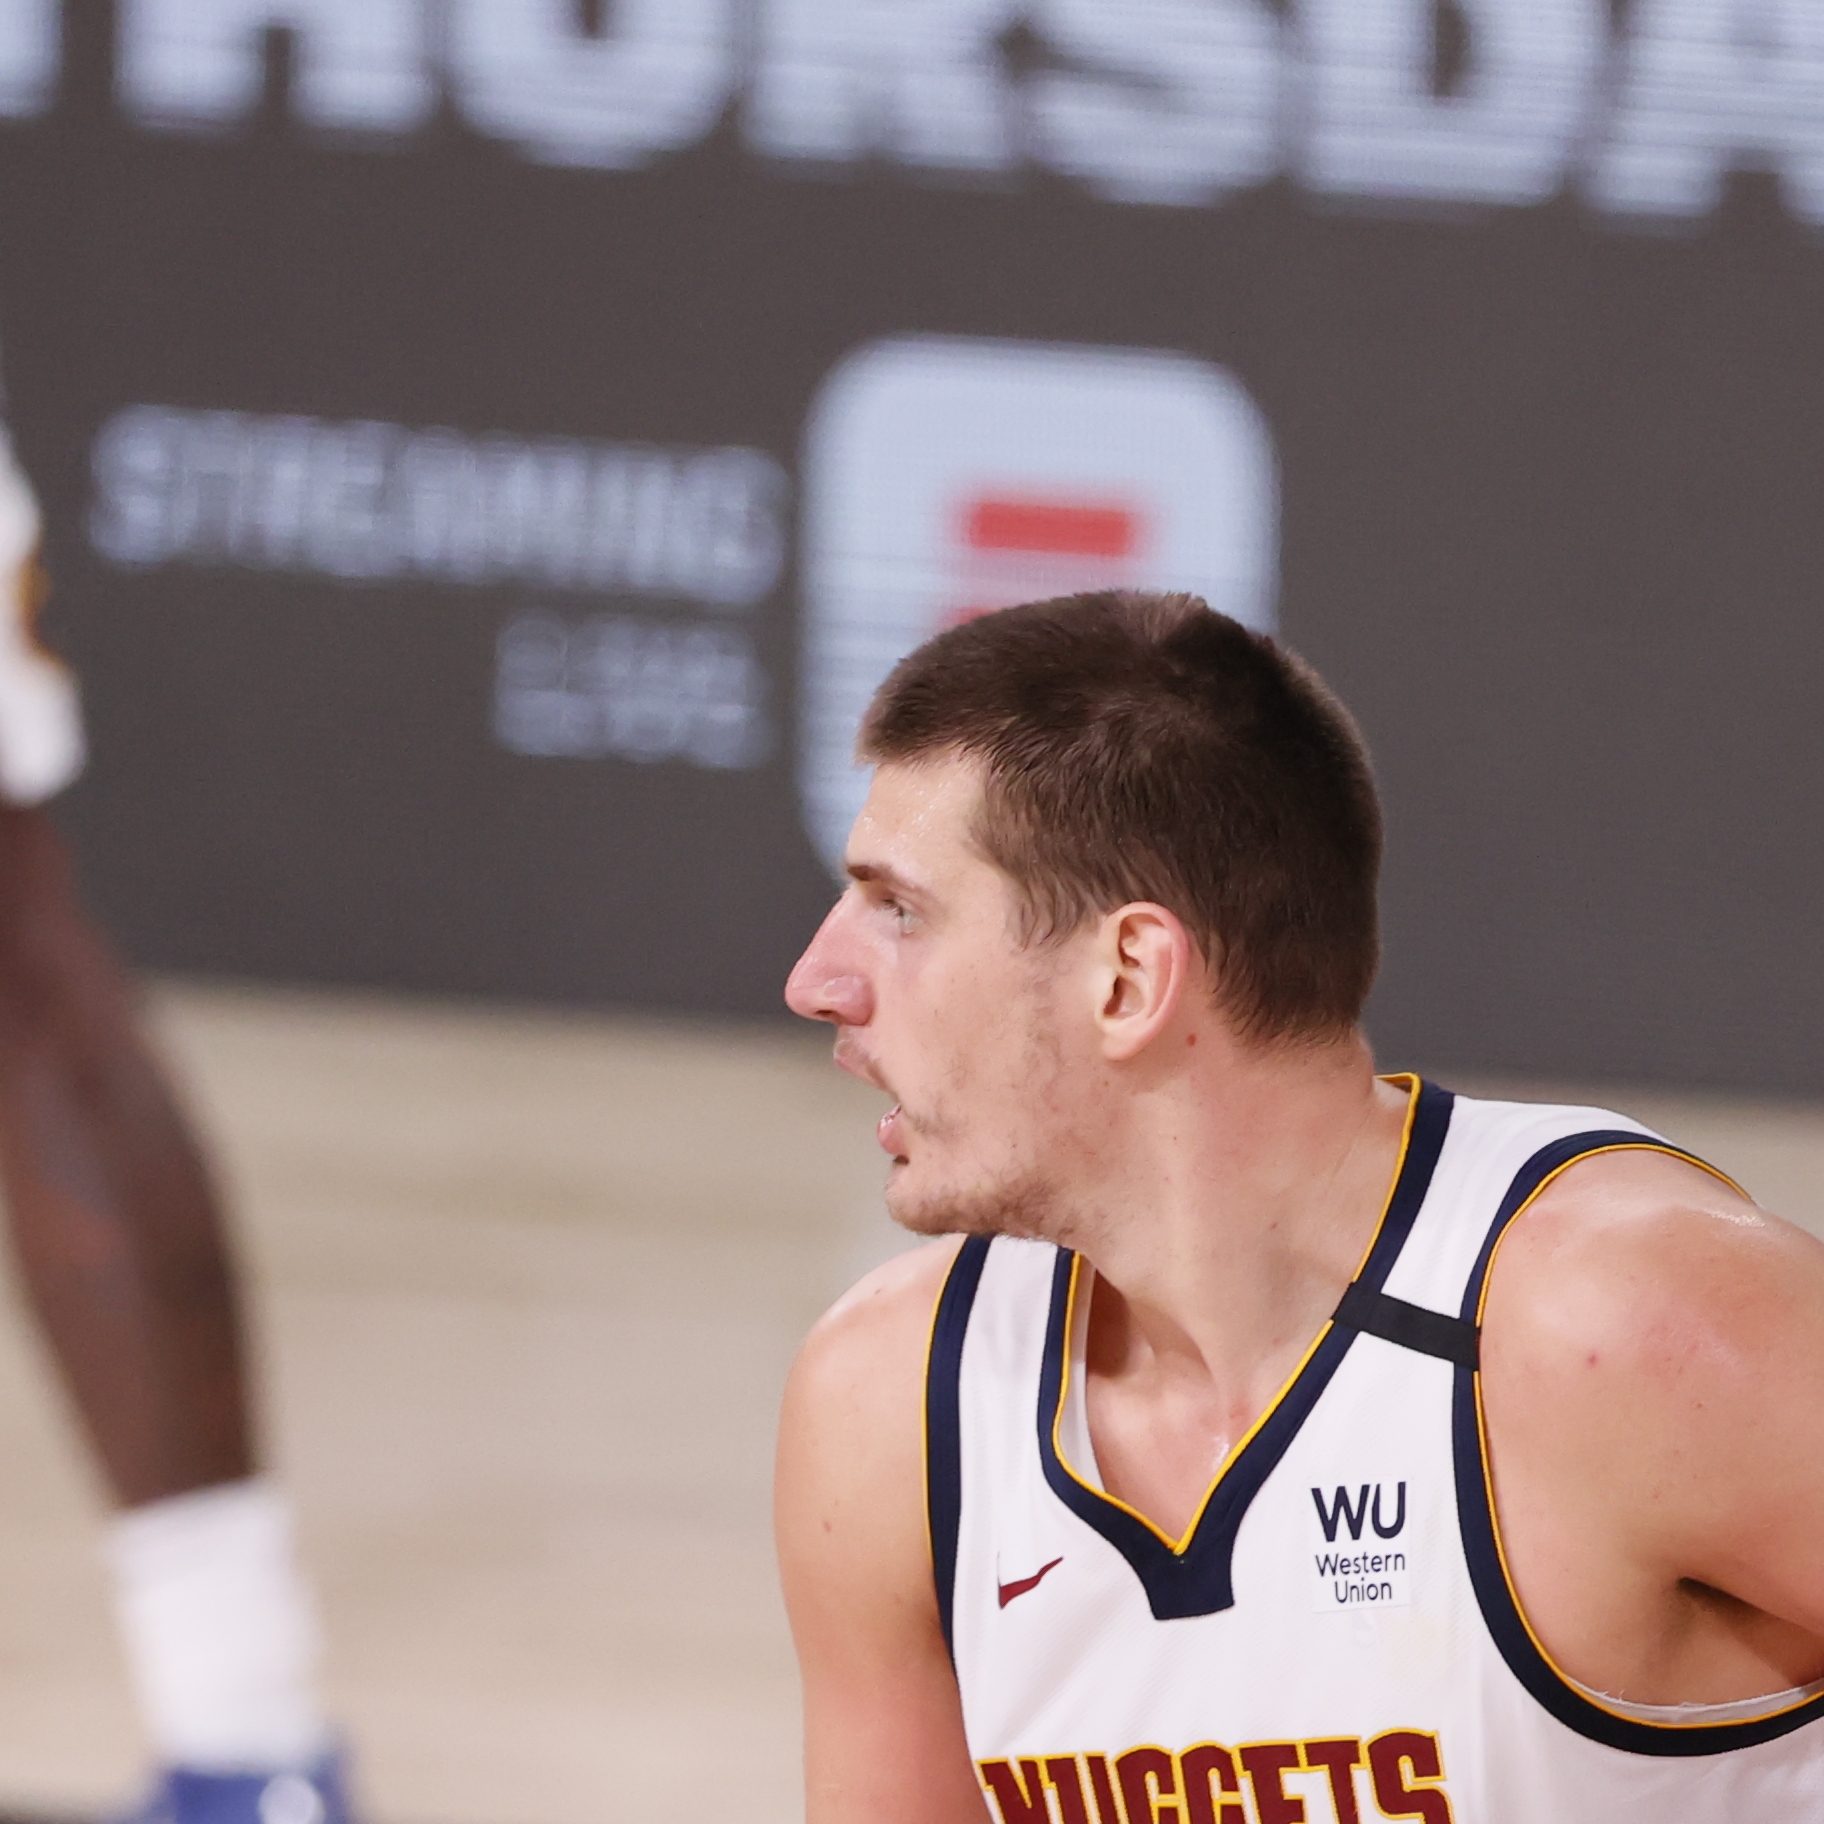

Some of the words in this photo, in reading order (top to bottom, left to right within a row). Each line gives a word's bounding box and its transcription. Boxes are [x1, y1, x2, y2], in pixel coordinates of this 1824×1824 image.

[1310, 1480, 1407, 1543] WU
[1314, 1551, 1406, 1578] Western
[1334, 1577, 1393, 1604] Union
